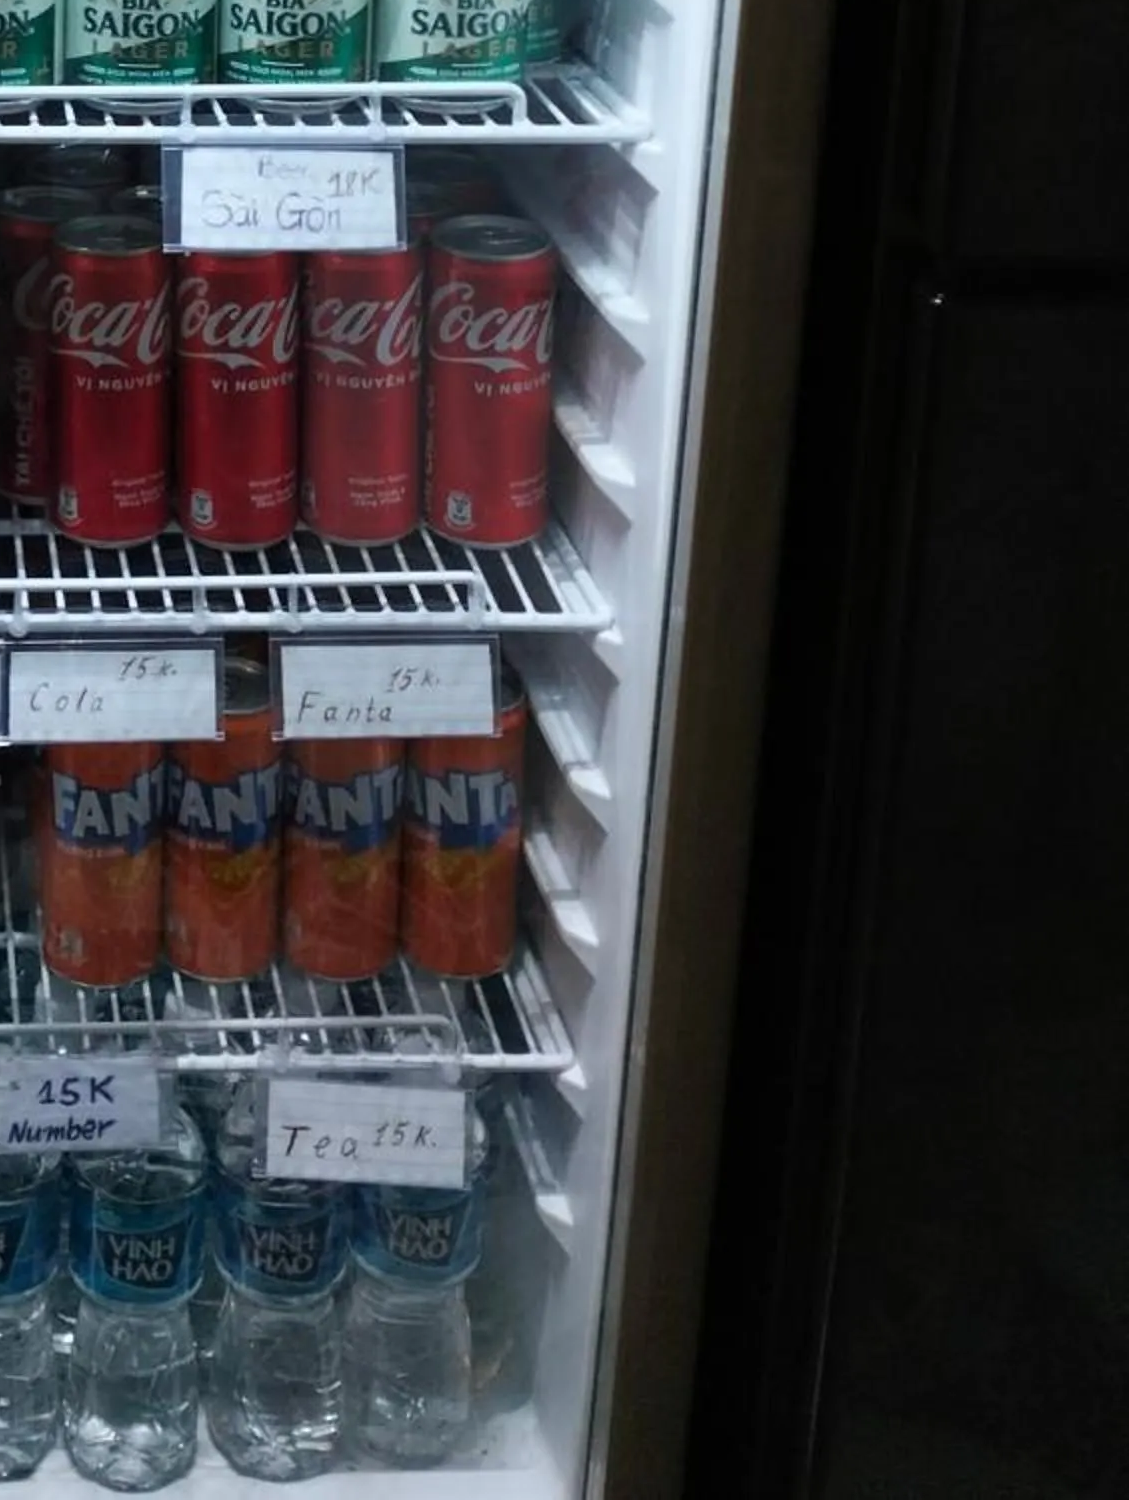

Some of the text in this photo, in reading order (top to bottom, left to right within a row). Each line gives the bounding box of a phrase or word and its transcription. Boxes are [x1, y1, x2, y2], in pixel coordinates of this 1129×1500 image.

[83, 6, 200, 38] SAIGON
[231, 3, 348, 37] SAIGON
[30, 683, 104, 713] Cola
[296, 689, 394, 725] Fanta
[37, 1075, 114, 1106] 15K
[8, 1116, 118, 1143] Number
[281, 1125, 360, 1159] Tea
